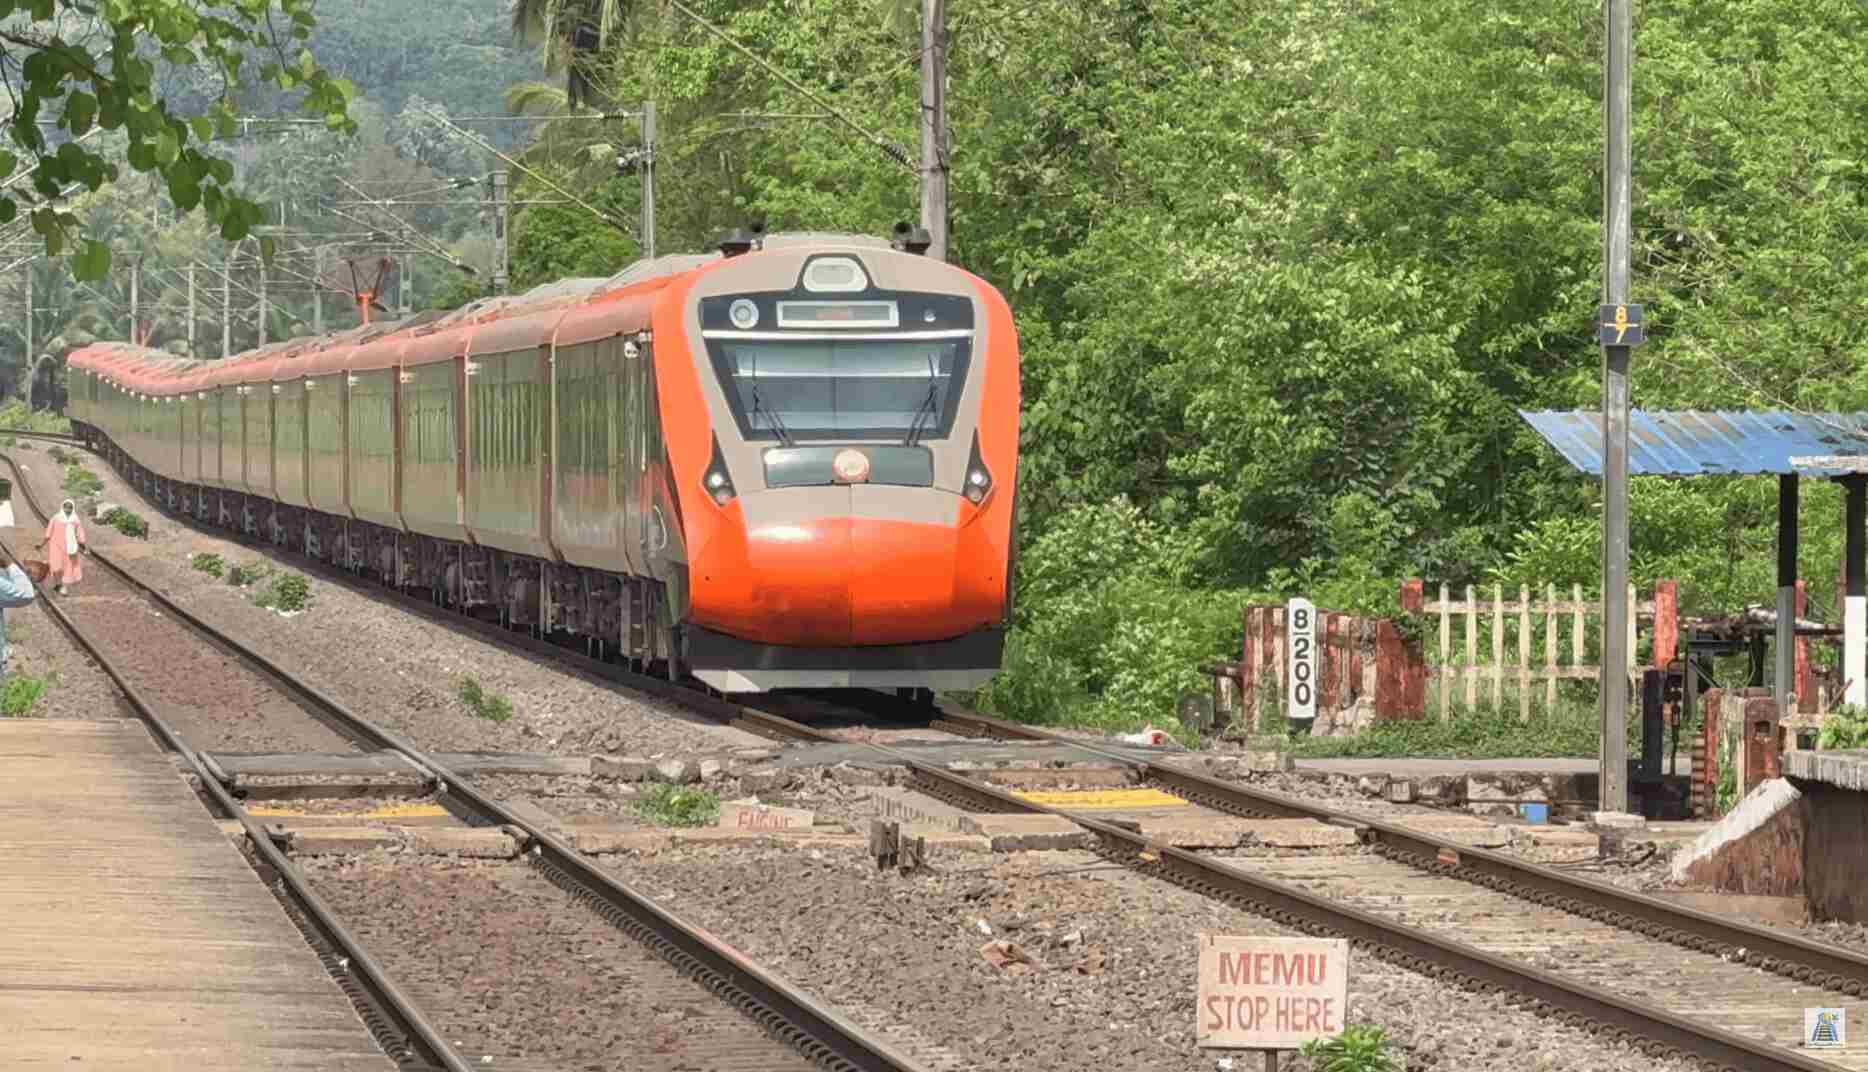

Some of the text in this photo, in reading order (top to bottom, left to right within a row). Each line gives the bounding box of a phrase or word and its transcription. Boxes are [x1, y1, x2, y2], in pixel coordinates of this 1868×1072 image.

[1615, 305, 1627, 322] 8
[1294, 609, 1308, 629] 8
[1218, 951, 1327, 986] MEMU
[1207, 995, 1335, 1032] STOP HERE
